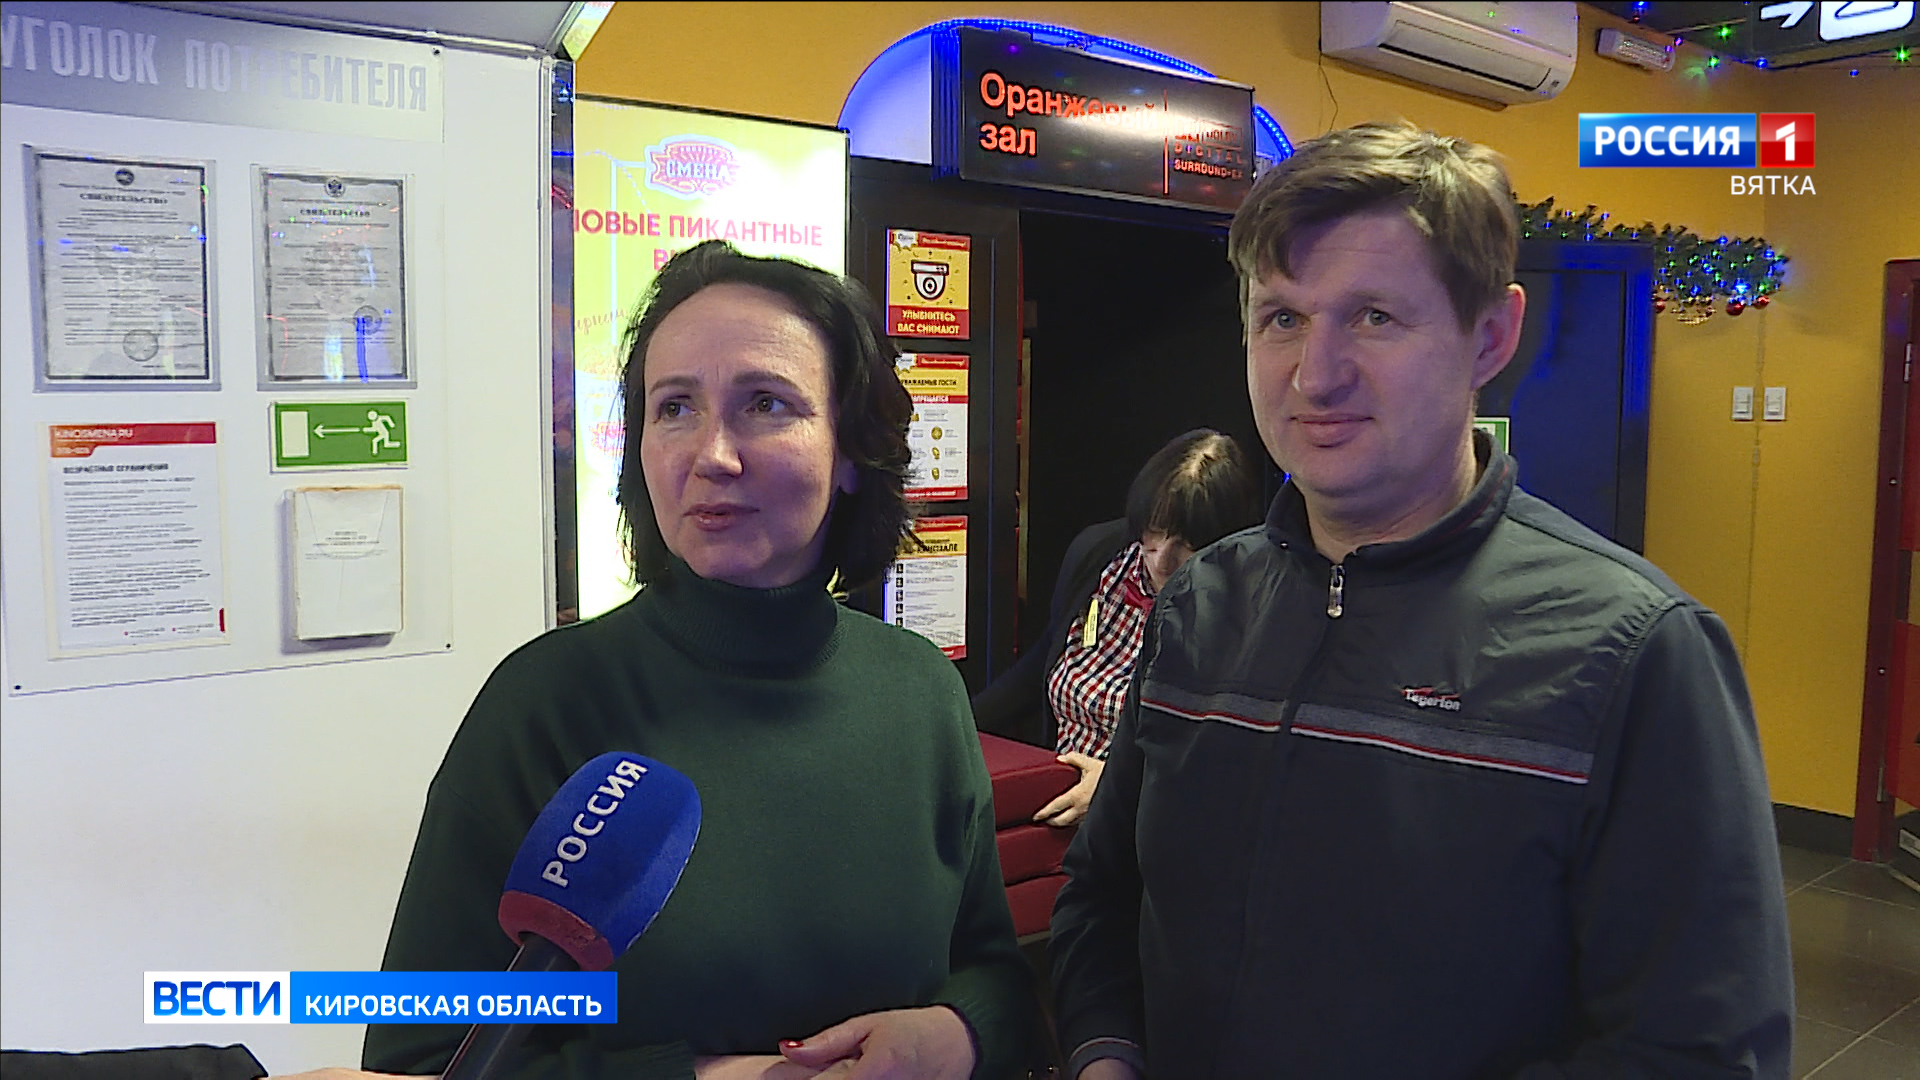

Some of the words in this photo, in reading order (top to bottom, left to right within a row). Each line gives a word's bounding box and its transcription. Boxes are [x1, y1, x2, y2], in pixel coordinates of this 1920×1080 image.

[184, 39, 427, 112] ПОТРЕБИТЕЛЯ
[979, 122, 1037, 157] зал
[1174, 142, 1243, 164] DIGITAL
[666, 159, 730, 181] СМЕНА
[669, 214, 822, 247] ПИКАНТНЫЕ
[897, 322, 915, 333] ВАС
[916, 324, 960, 335] СНИМАЮТ
[902, 309, 956, 322] УЛЫБНИТЕСЬ
[542, 760, 648, 888] РОССИЯ
